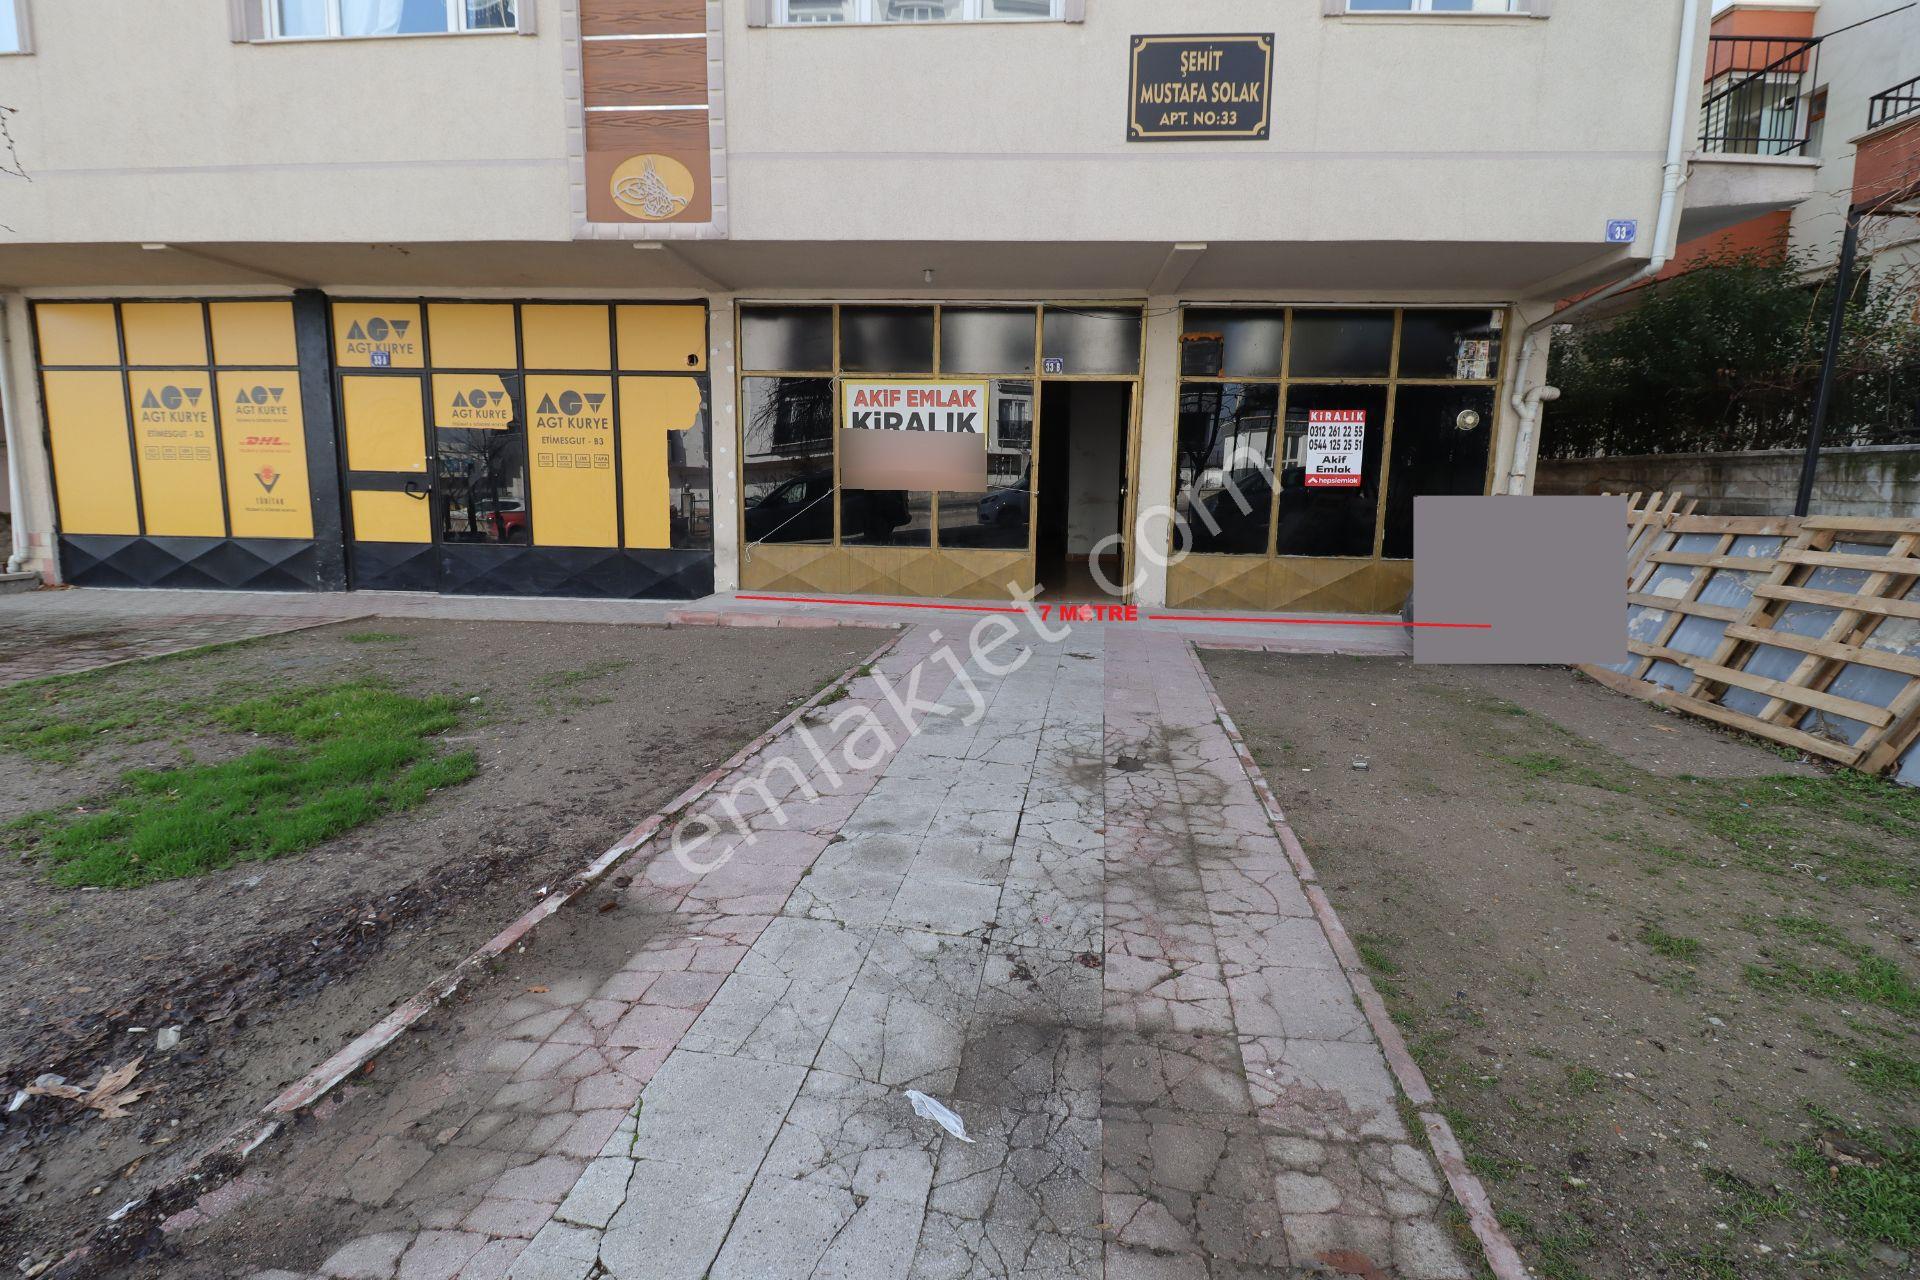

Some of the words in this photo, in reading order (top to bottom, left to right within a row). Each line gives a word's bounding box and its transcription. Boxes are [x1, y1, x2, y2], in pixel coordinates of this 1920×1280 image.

[1180, 45, 1223, 77] ŞEHİT
[1140, 82, 1207, 104] MUSTAFA
[1211, 81, 1260, 103] SOLAK
[1159, 111, 1188, 126] APT.
[1193, 111, 1237, 125] NO:33
[1615, 226, 1627, 240] 33
[347, 342, 371, 353] AGT
[375, 343, 413, 354] KURYE
[1045, 362, 1054, 372] 33
[906, 389, 977, 407] EMLAK
[236, 405, 255, 415] AGT
[258, 406, 288, 415] KURYE
[452, 409, 472, 419] AGT
[475, 409, 507, 419] KURYE
[142, 411, 166, 423] AGT
[169, 411, 208, 423] KURYE
[537, 416, 563, 428] AGT
[568, 417, 608, 430] KURYE
[1309, 426, 1326, 437] 0312
[1328, 426, 1340, 437] 261
[1343, 426, 1351, 437] 22
[1354, 426, 1363, 437] 55
[541, 434, 586, 445] ETİMESGUT
[1308, 439, 1327, 450] 0544
[1329, 439, 1340, 450] 125
[1343, 440, 1352, 450] 25
[1354, 440, 1362, 450] 51
[1322, 455, 1347, 464] Akif
[1318, 477, 1358, 485] hepsiemlak
